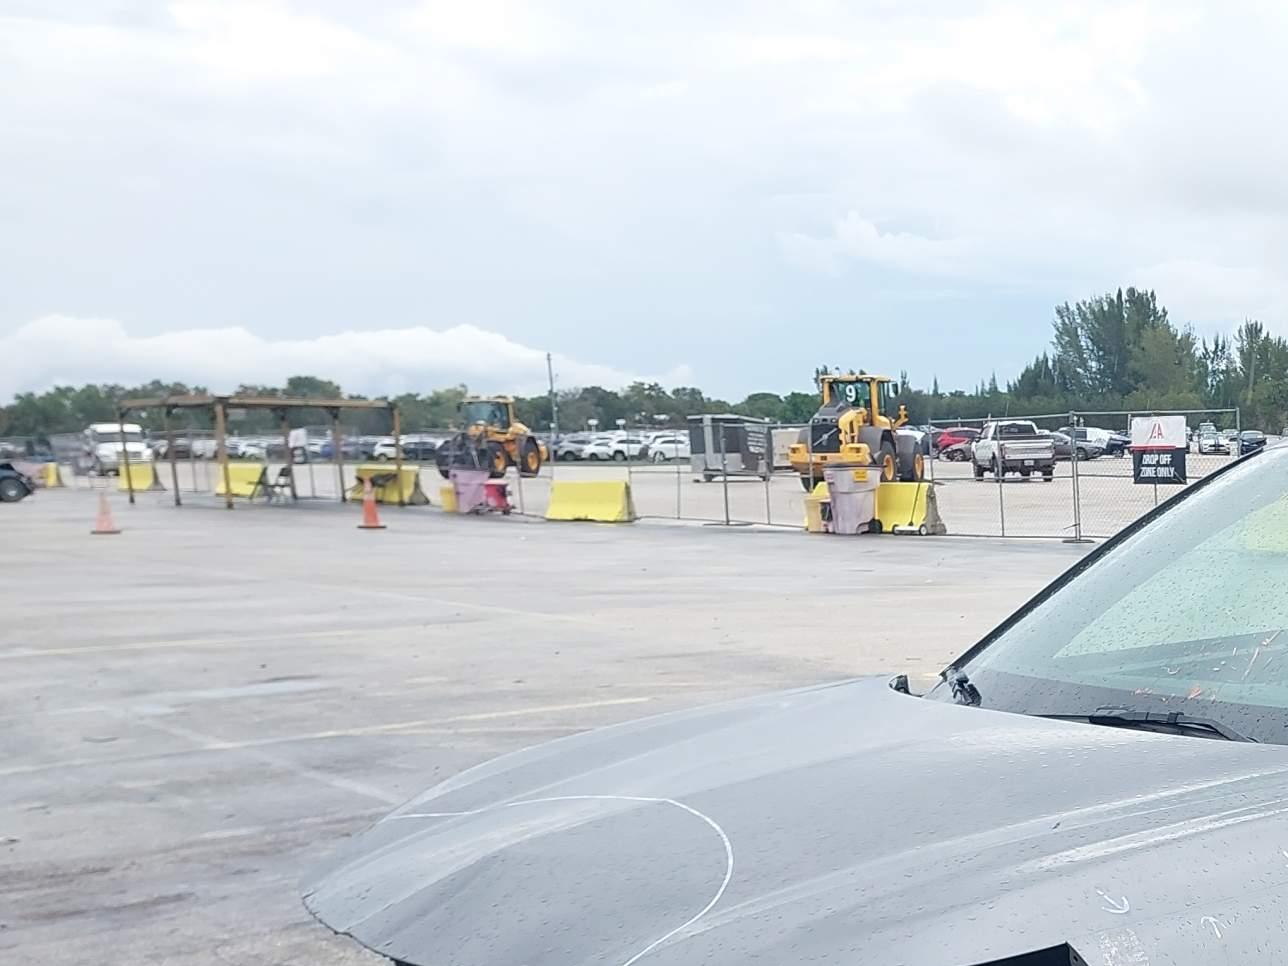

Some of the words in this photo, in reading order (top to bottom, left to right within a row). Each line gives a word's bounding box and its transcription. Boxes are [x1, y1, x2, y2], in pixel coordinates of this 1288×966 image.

[846, 384, 857, 402] 9
[1142, 454, 1158, 465] DROP
[1160, 454, 1172, 465] OFF
[1140, 466, 1156, 477] ZONE
[1156, 466, 1175, 477] ONLY
